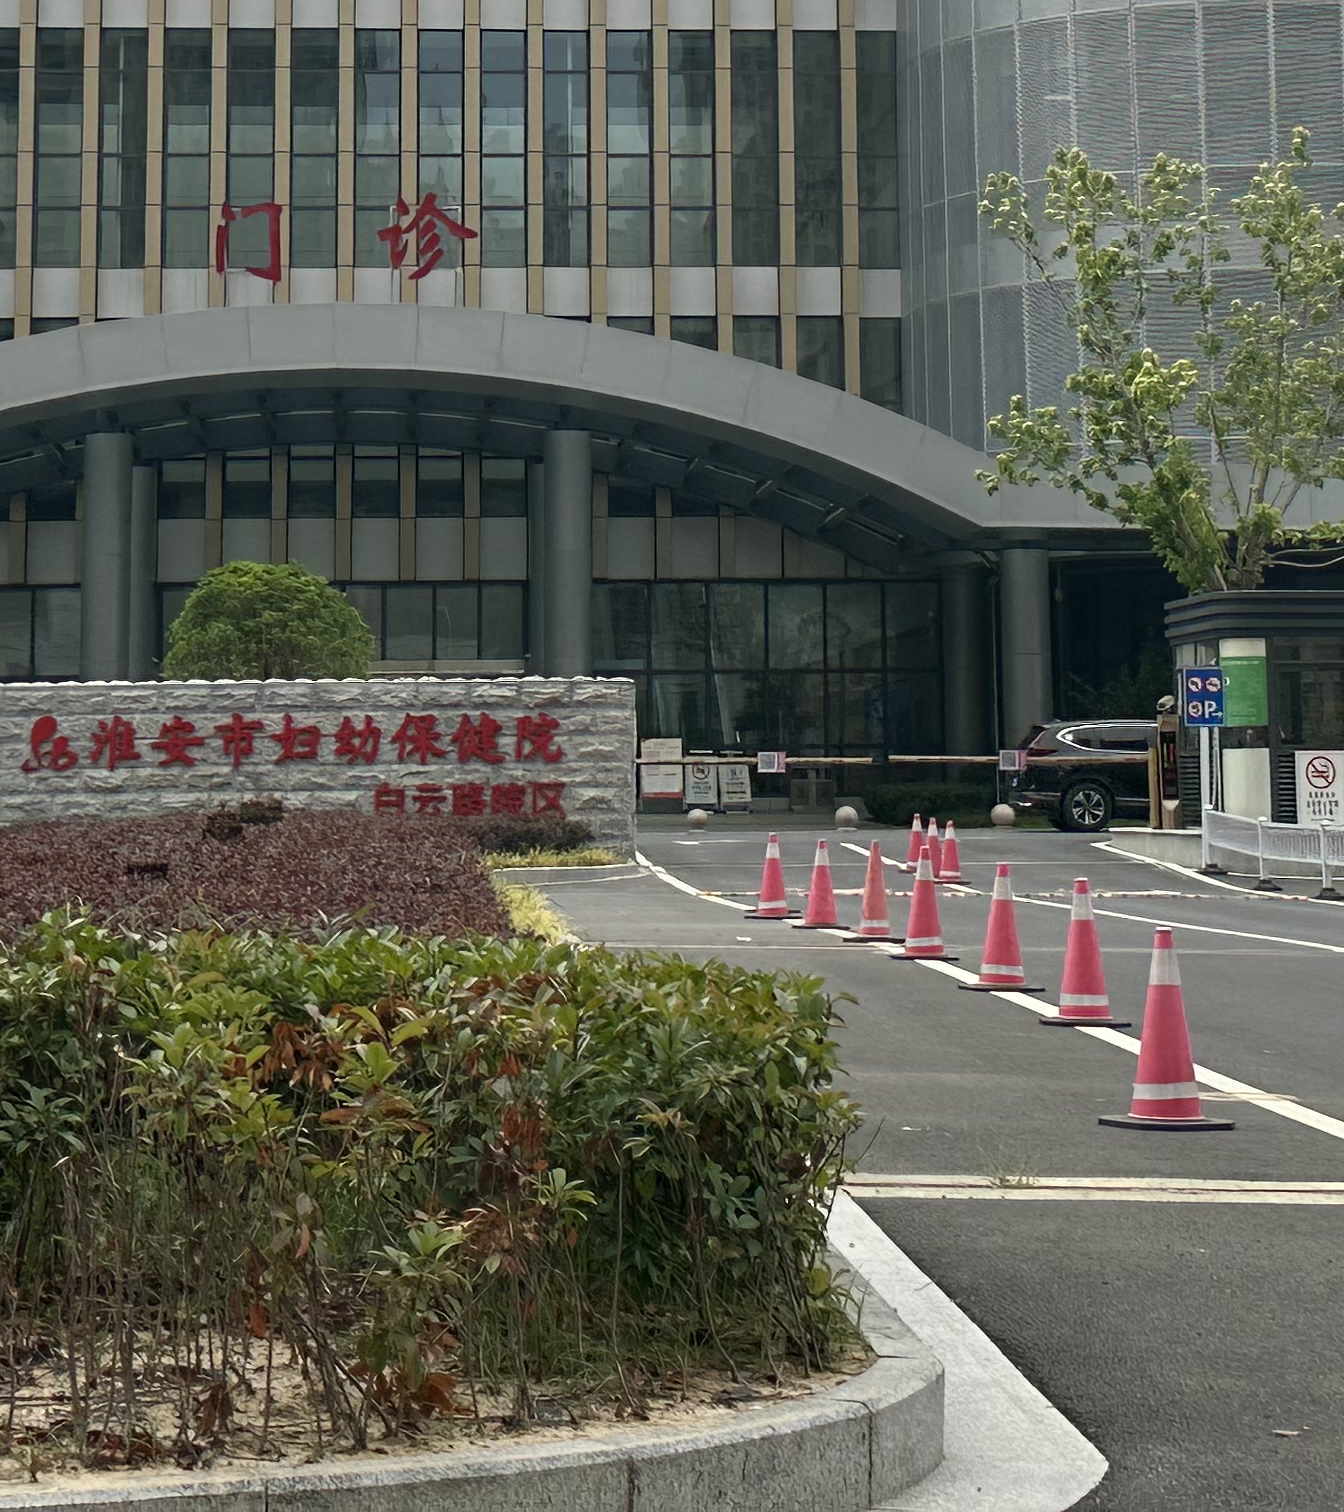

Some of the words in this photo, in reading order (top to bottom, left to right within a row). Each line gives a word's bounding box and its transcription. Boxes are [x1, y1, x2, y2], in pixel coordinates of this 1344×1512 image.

[216, 192, 478, 282] 门诊
[89, 711, 565, 772] 淮安市妇幼保健院
